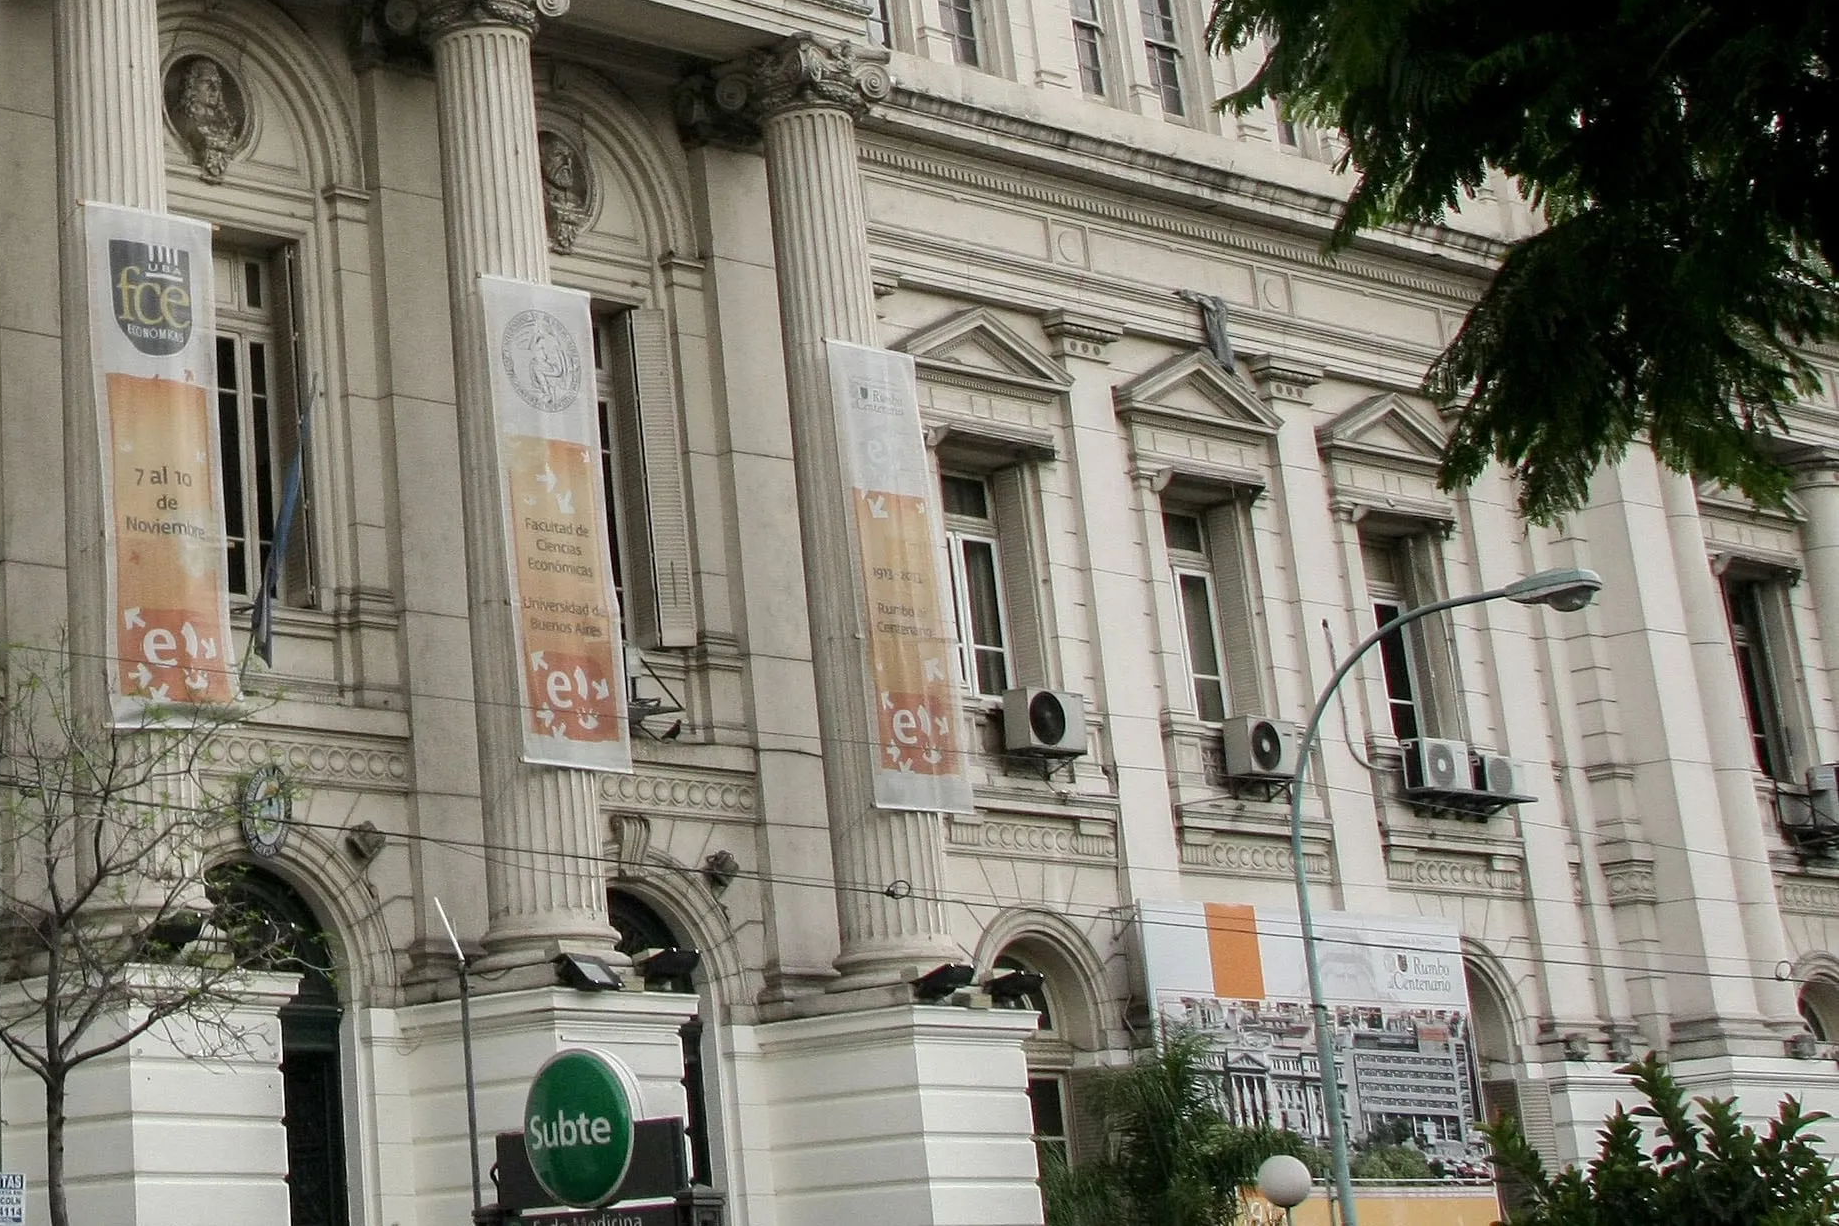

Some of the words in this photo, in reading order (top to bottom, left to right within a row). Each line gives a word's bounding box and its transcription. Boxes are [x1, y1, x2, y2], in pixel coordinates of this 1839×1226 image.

[147, 262, 181, 276] UBA
[118, 265, 192, 329] fce
[134, 468, 144, 486] 7
[150, 465, 168, 485] al
[174, 470, 192, 487] 10
[156, 495, 178, 510] de
[126, 515, 206, 540] Noviembre
[525, 517, 573, 535] Facultad
[575, 524, 589, 538] de
[536, 538, 582, 556] Ciencias
[523, 596, 589, 615] Universidad
[530, 617, 573, 633] Buenos
[1412, 956, 1450, 976] Rumbo
[530, 1109, 612, 1150] Subte
